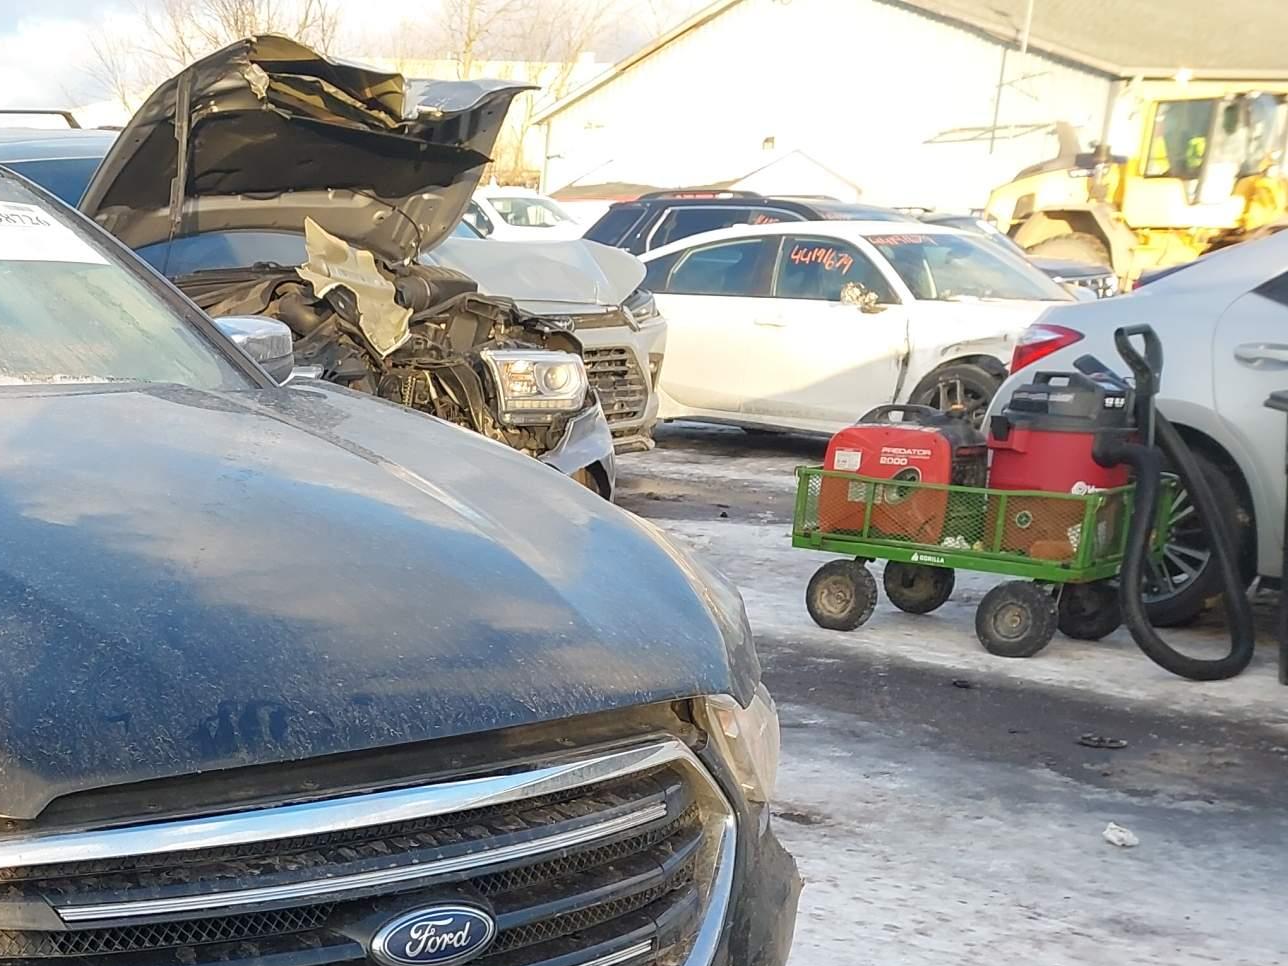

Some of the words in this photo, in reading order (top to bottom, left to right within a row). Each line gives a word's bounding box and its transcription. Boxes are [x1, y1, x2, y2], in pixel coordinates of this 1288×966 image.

[791, 244, 853, 276] 44191679
[881, 447, 932, 456] PREDATOR
[880, 457, 908, 466] 2000
[919, 554, 945, 564] GORILLA
[405, 917, 472, 958] Ford
